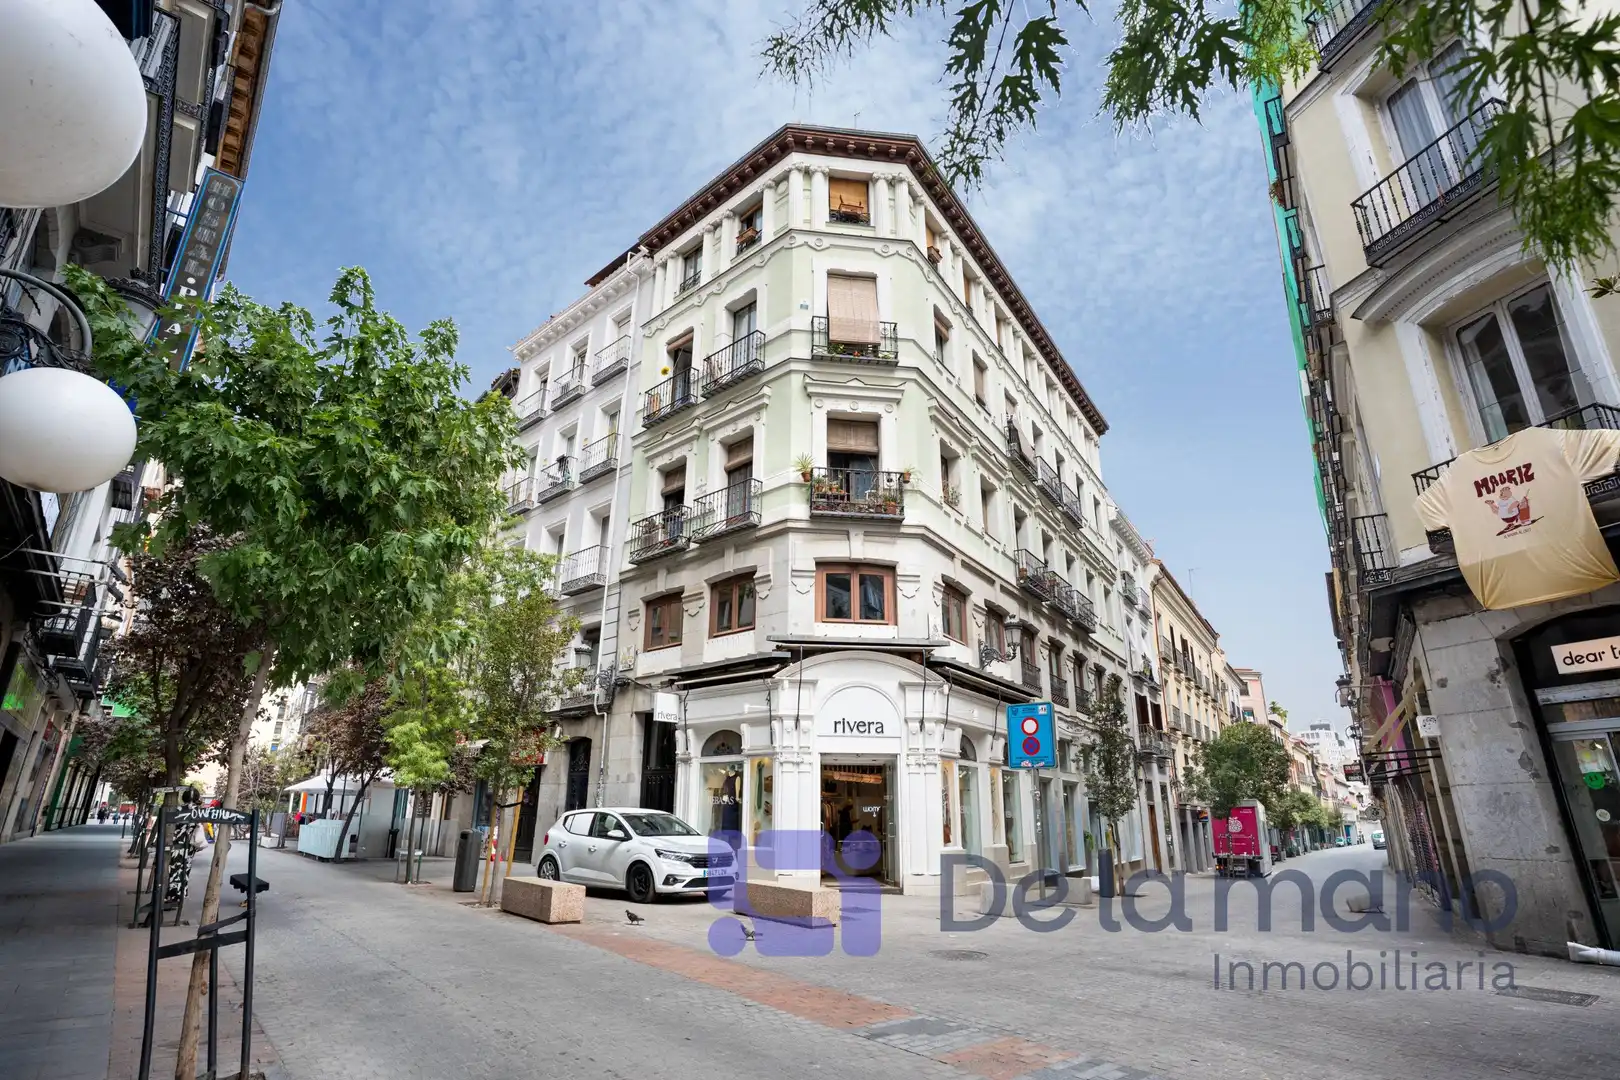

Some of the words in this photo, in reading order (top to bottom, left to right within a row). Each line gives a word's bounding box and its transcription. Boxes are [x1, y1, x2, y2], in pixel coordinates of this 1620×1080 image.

[1474, 463, 1535, 498] MADRIZ
[1562, 650, 1606, 666] dear
[1610, 644, 1620, 660] t
[657, 711, 677, 720] rivera
[833, 718, 885, 735] rivera
